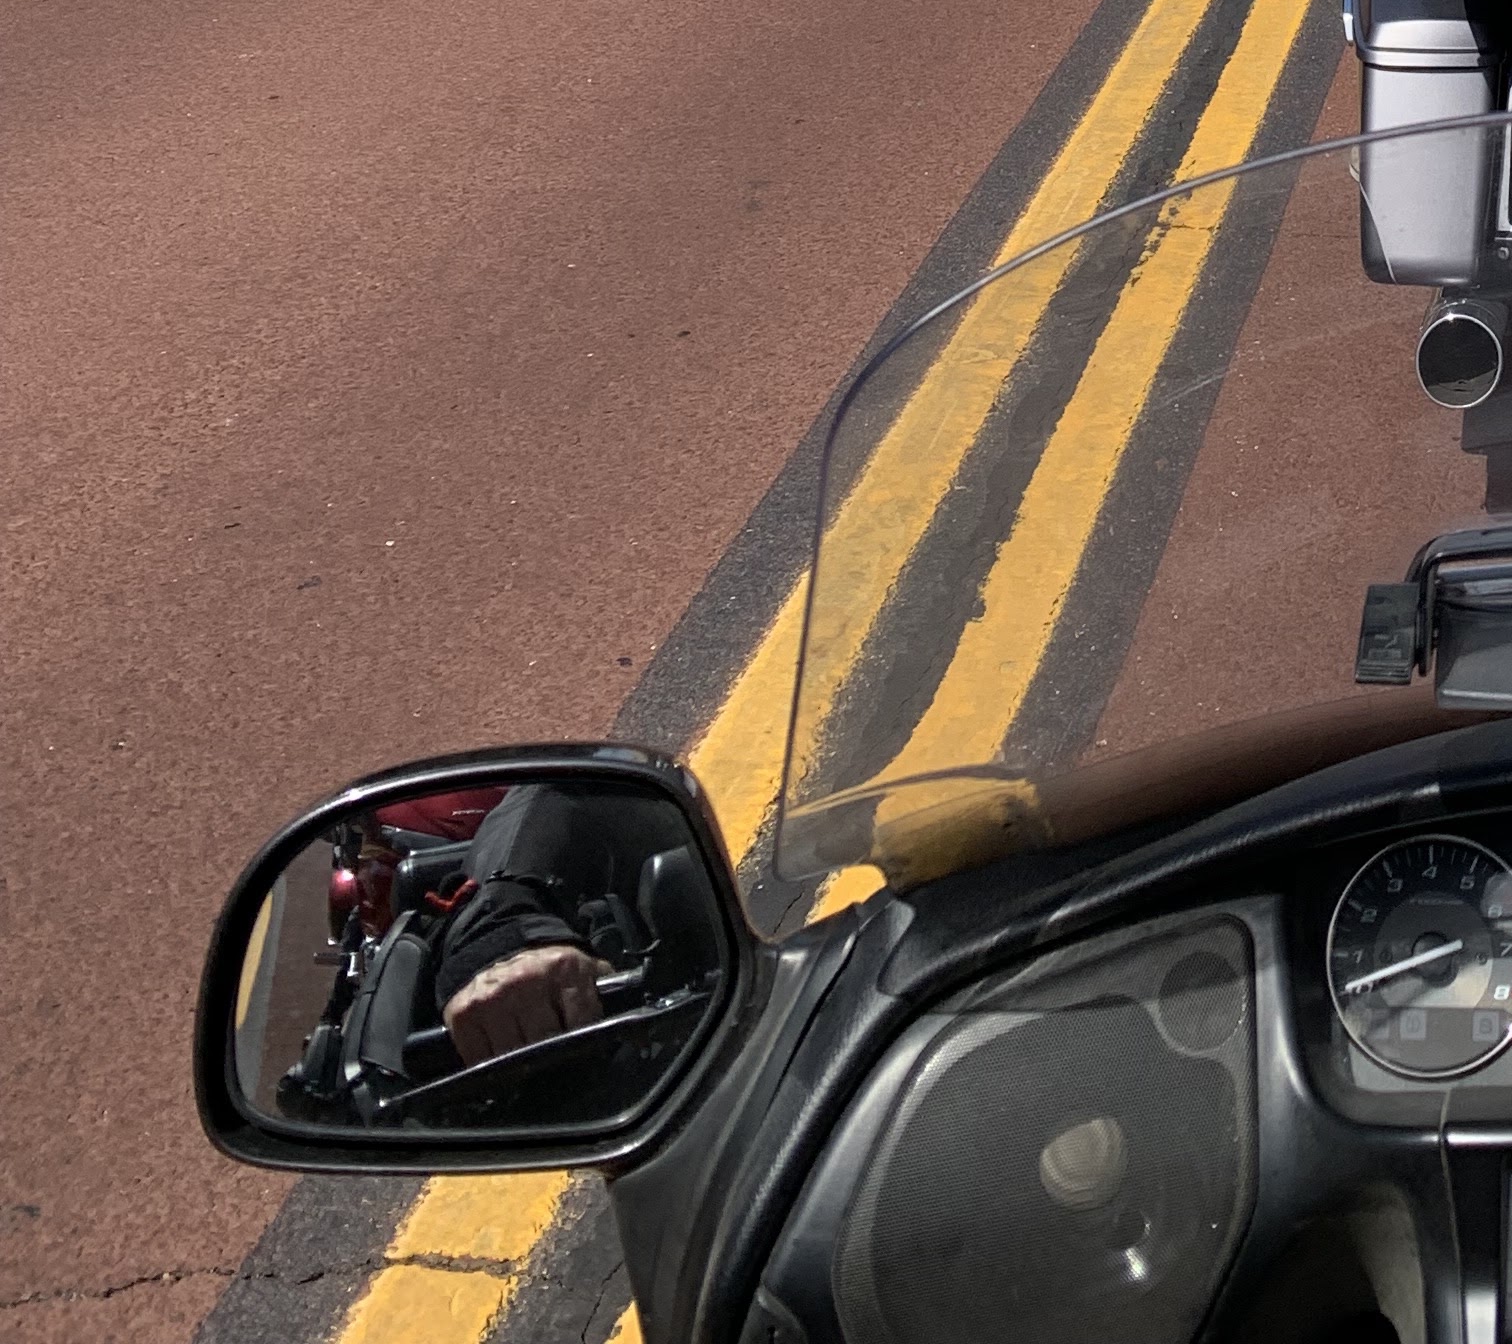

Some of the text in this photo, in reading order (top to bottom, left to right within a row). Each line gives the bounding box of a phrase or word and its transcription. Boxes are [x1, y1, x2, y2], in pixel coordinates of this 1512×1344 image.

[1422, 866, 1438, 879] 4
[1352, 950, 1363, 963] 1
[1493, 984, 1511, 1000] 8
